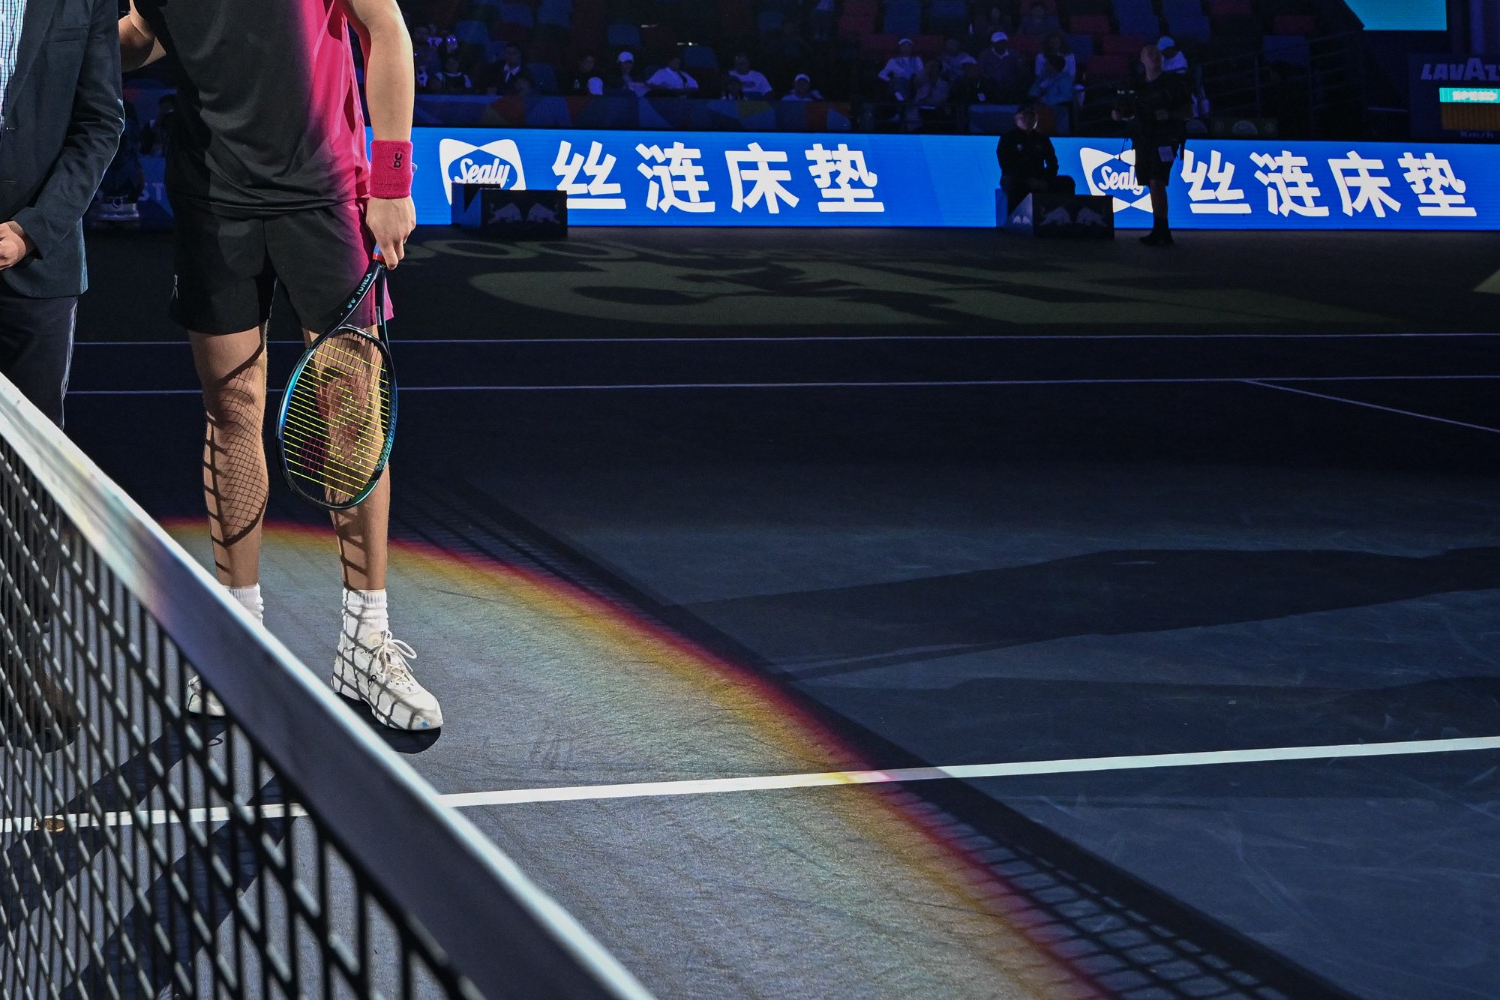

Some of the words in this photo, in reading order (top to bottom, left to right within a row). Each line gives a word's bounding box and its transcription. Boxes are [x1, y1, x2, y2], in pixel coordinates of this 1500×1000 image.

[454, 158, 511, 189] Sealy
[552, 141, 884, 214] 丝涟床垫
[1181, 150, 1477, 217] 丝涟床垫
